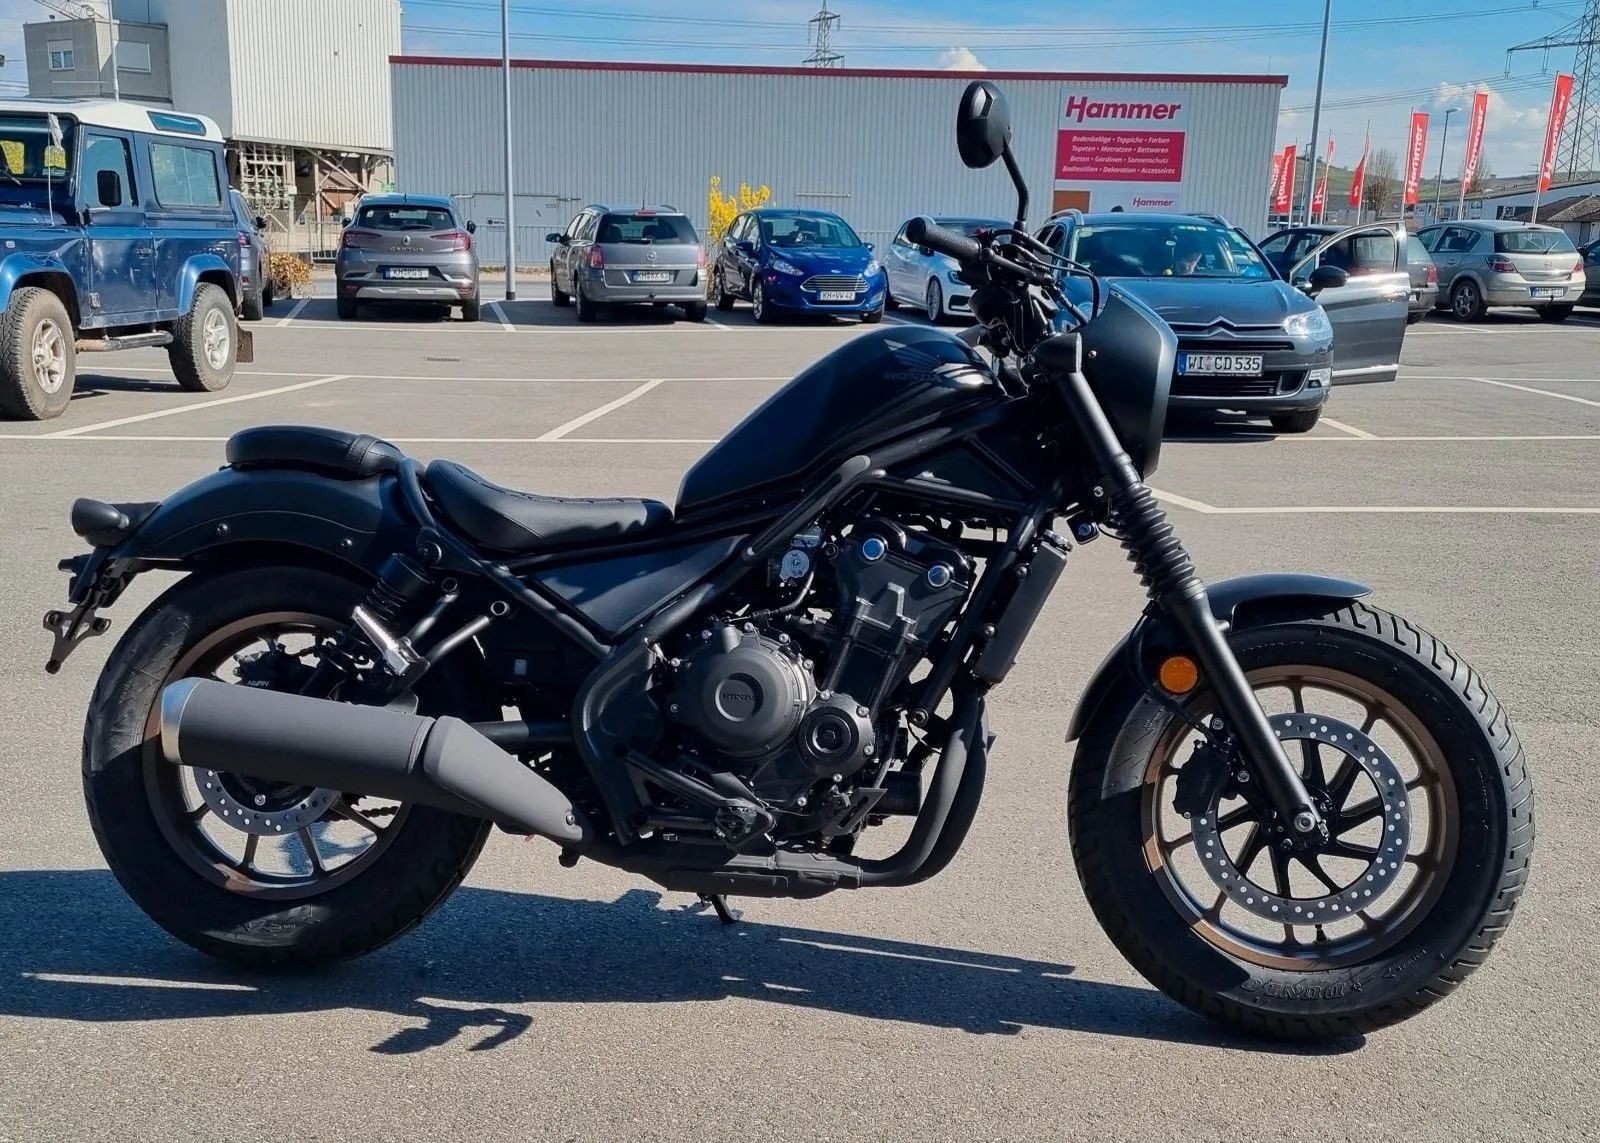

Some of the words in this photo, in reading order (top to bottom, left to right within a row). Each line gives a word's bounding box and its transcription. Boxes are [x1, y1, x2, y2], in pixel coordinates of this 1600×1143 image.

[1065, 95, 1182, 123] Hammer
[1071, 135, 1111, 144] Bodenbeläge
[1116, 136, 1143, 144] Teppiche
[1071, 145, 1096, 153] Tapeten
[1407, 123, 1425, 194] Hammer
[1062, 165, 1098, 173] Badtextilien
[1102, 166, 1136, 174] Dekoration
[1132, 197, 1175, 208] Hammer
[1188, 356, 1204, 370] WI
[1214, 356, 1233, 370] CD
[1235, 356, 1260, 371] 535
[1238, 978, 1346, 1000] DUNLO
